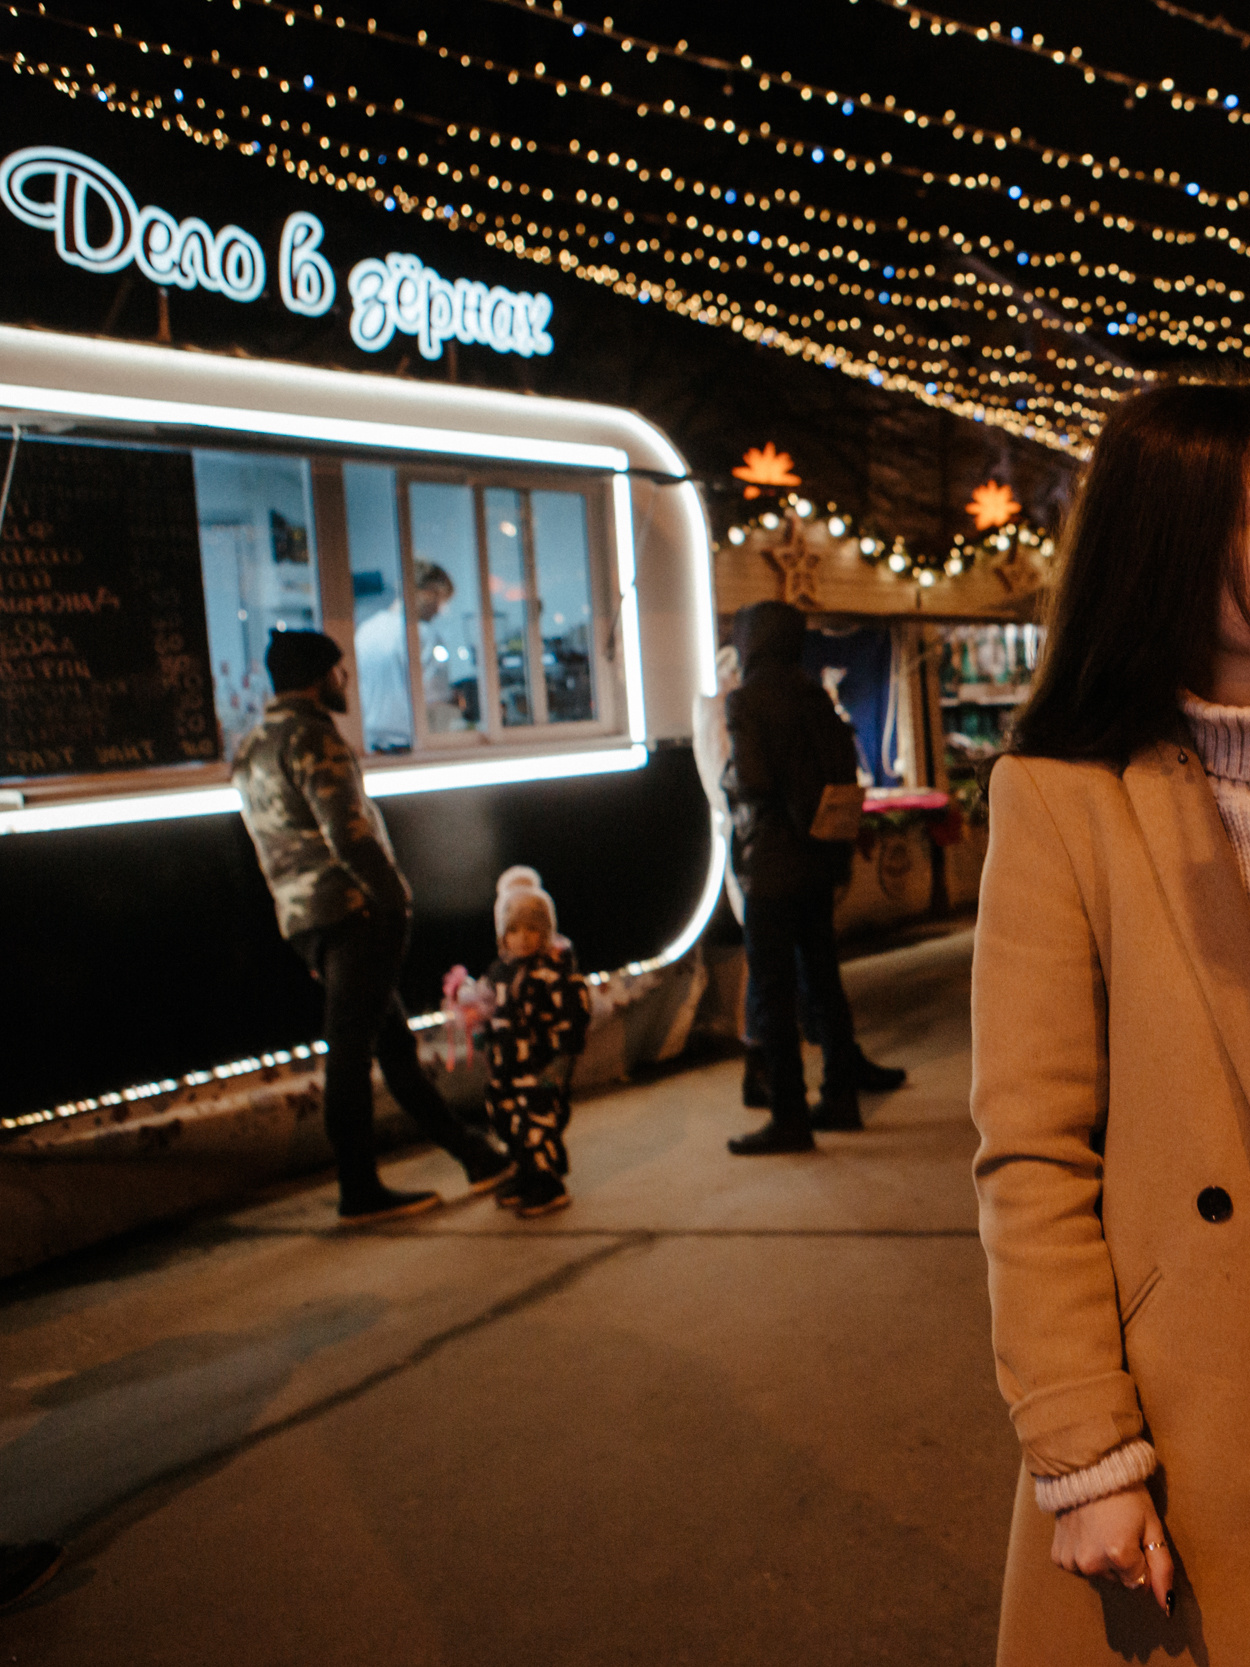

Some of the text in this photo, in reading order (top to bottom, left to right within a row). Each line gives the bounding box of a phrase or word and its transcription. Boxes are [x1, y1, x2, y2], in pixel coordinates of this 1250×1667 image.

[0, 146, 555, 360] Дело в зёрнах
